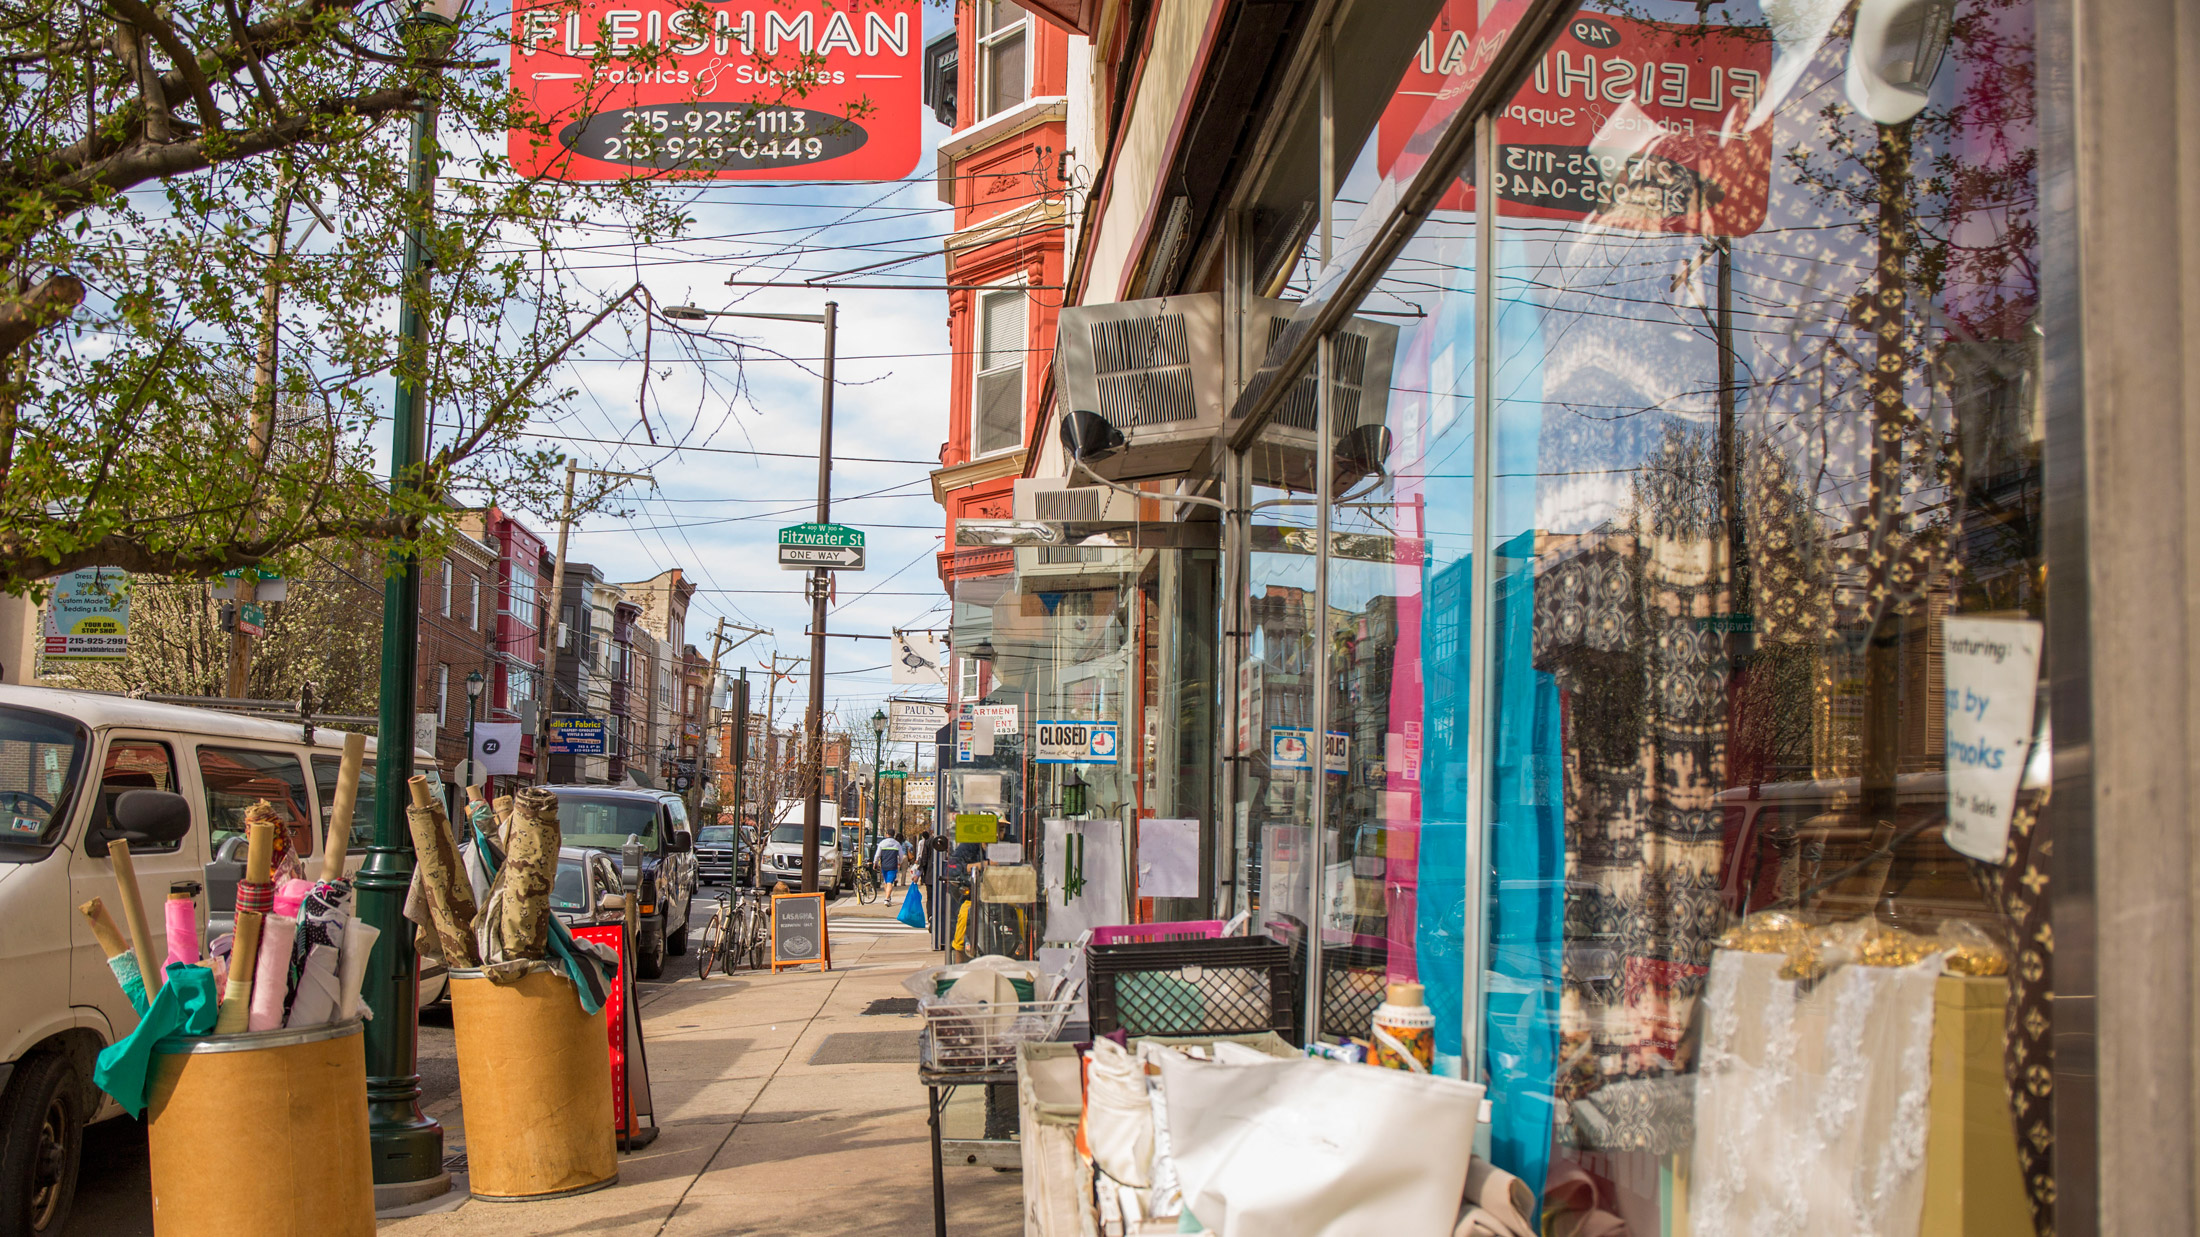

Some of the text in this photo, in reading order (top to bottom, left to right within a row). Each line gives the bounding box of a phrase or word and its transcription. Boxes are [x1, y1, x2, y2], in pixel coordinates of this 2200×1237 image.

[522, 10, 909, 57] FLEISHMAN
[594, 66, 689, 84] Fabrics
[736, 65, 845, 87] Supplies
[622, 111, 806, 134] 215-925-1113
[604, 136, 823, 160] 215-925-0449
[781, 530, 862, 546] Fitzwater St
[790, 551, 840, 560] ONE WAY
[905, 705, 935, 715] PAUL'S
[1965, 686, 1991, 721] by
[575, 720, 601, 728] Fabrics
[1040, 726, 1087, 746] CLOSED
[487, 743, 496, 751] Z!
